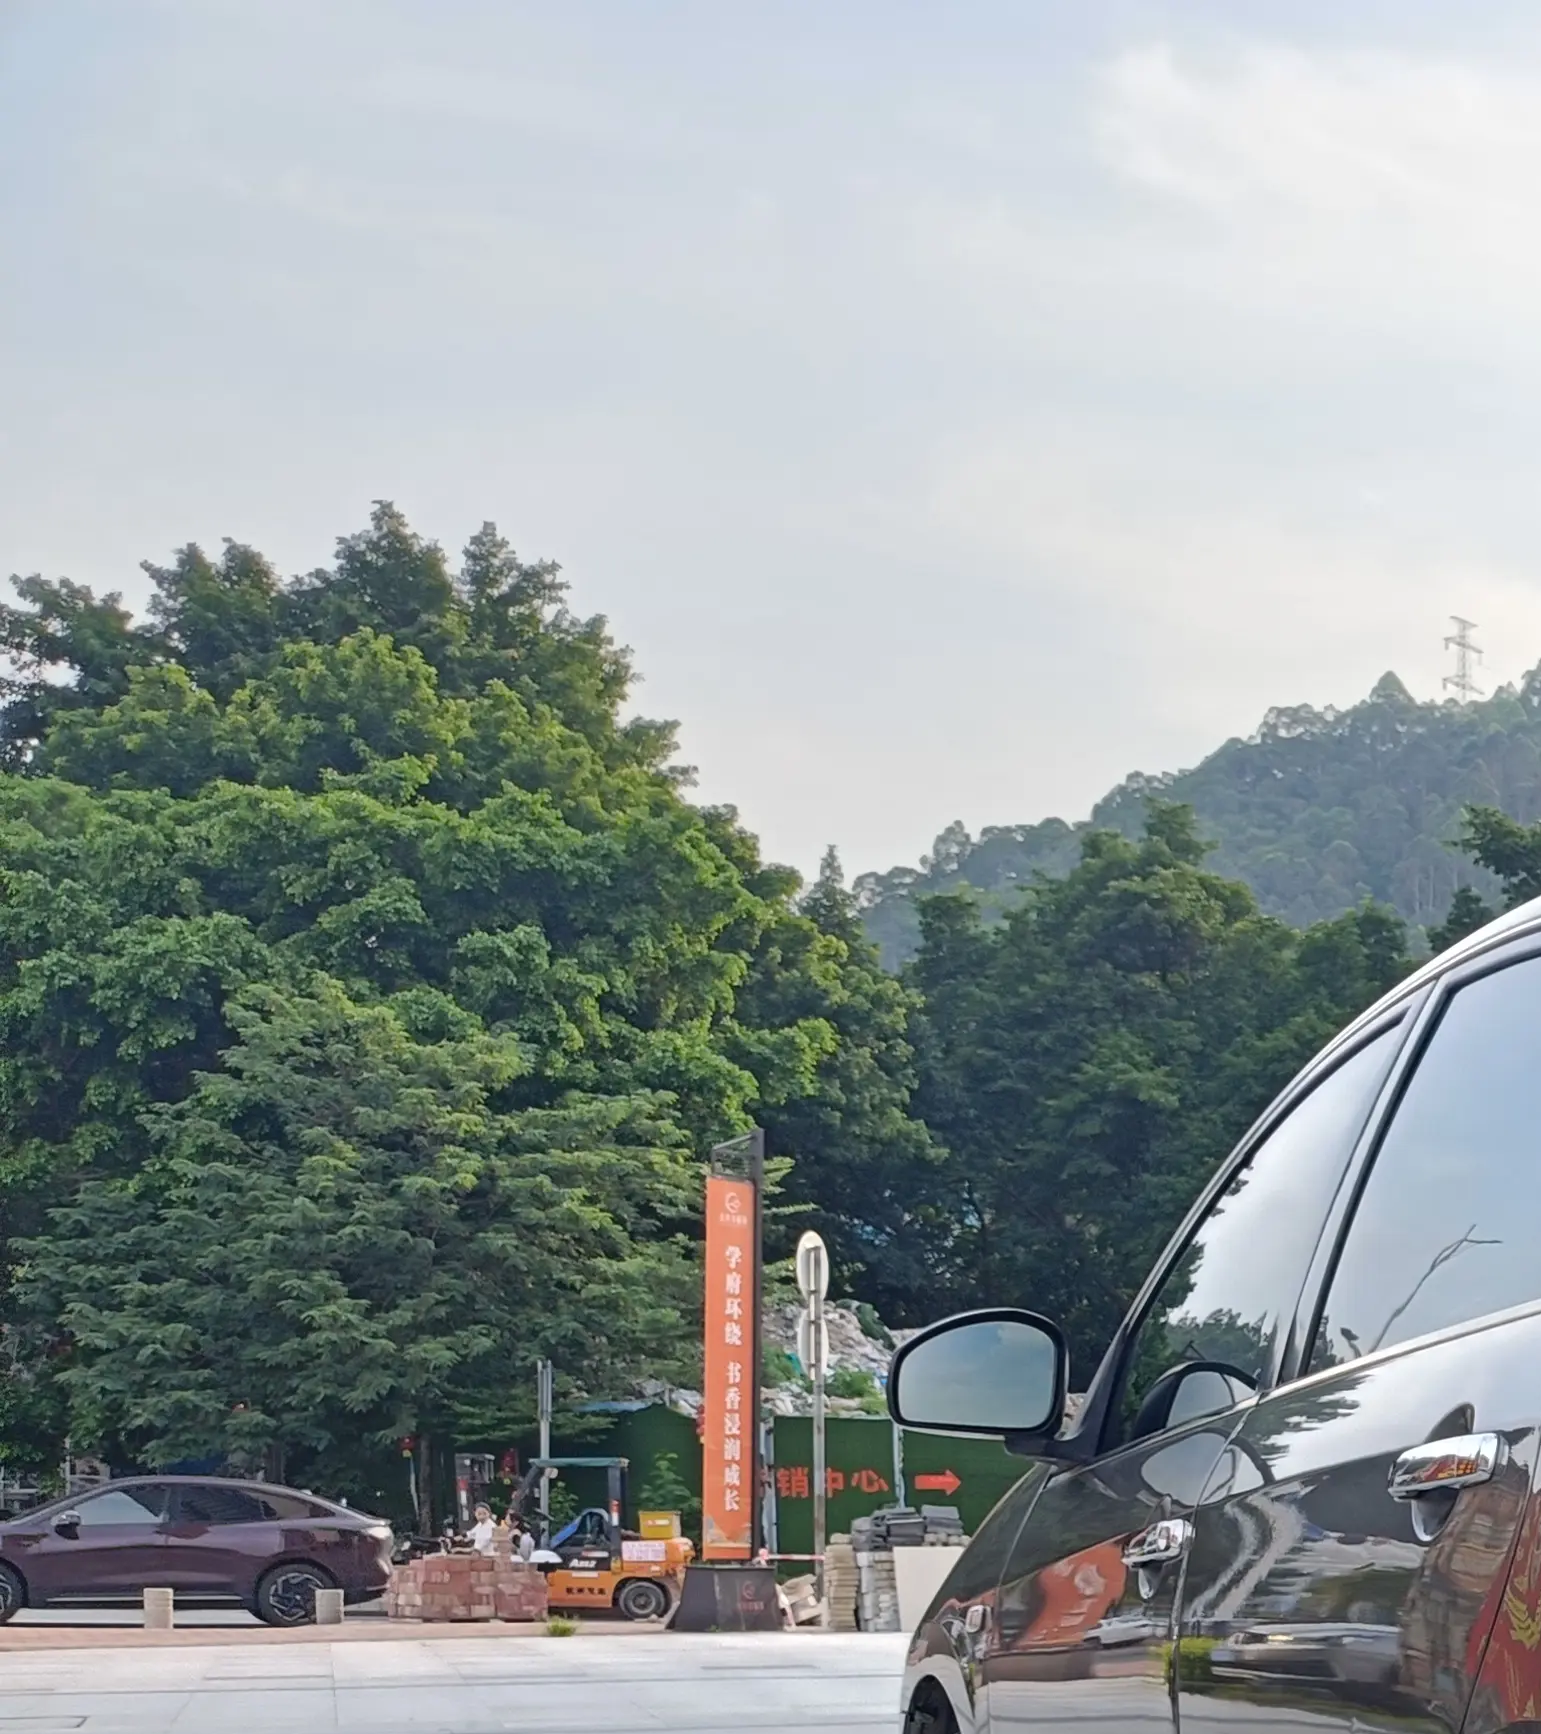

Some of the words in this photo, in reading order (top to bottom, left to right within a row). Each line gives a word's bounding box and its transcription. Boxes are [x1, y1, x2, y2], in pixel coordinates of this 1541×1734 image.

[724, 1245, 743, 1346] 学府环绕
[723, 1361, 743, 1512] 书香浸润成长
[760, 1466, 889, 1499] 销中心
